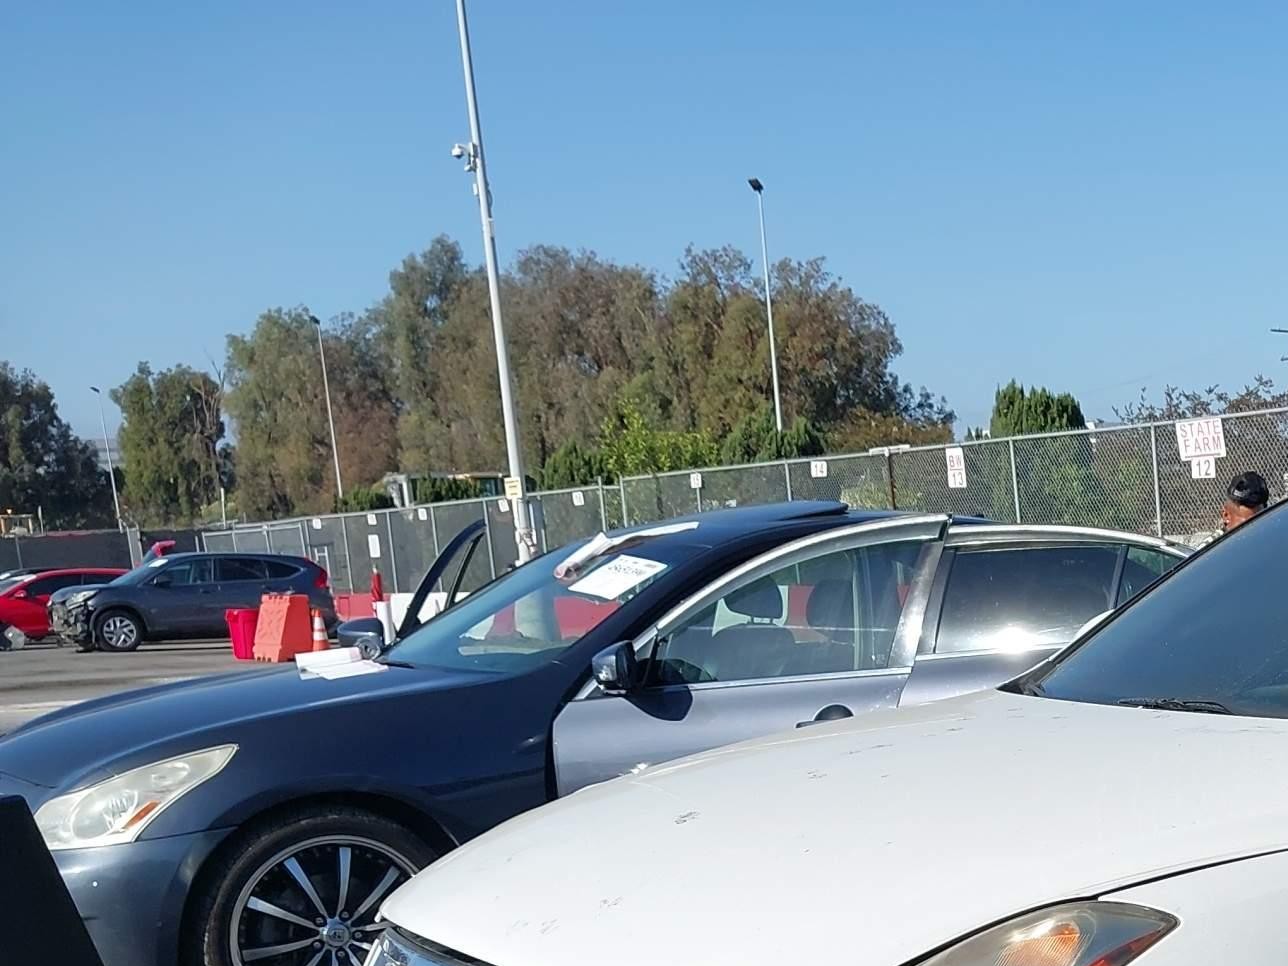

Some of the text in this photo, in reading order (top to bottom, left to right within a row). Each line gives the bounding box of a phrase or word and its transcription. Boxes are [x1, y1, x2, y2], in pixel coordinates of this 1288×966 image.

[1180, 420, 1221, 438] STATE
[1184, 435, 1222, 453] FARM
[1196, 459, 1211, 476] 12
[953, 471, 963, 486] 13
